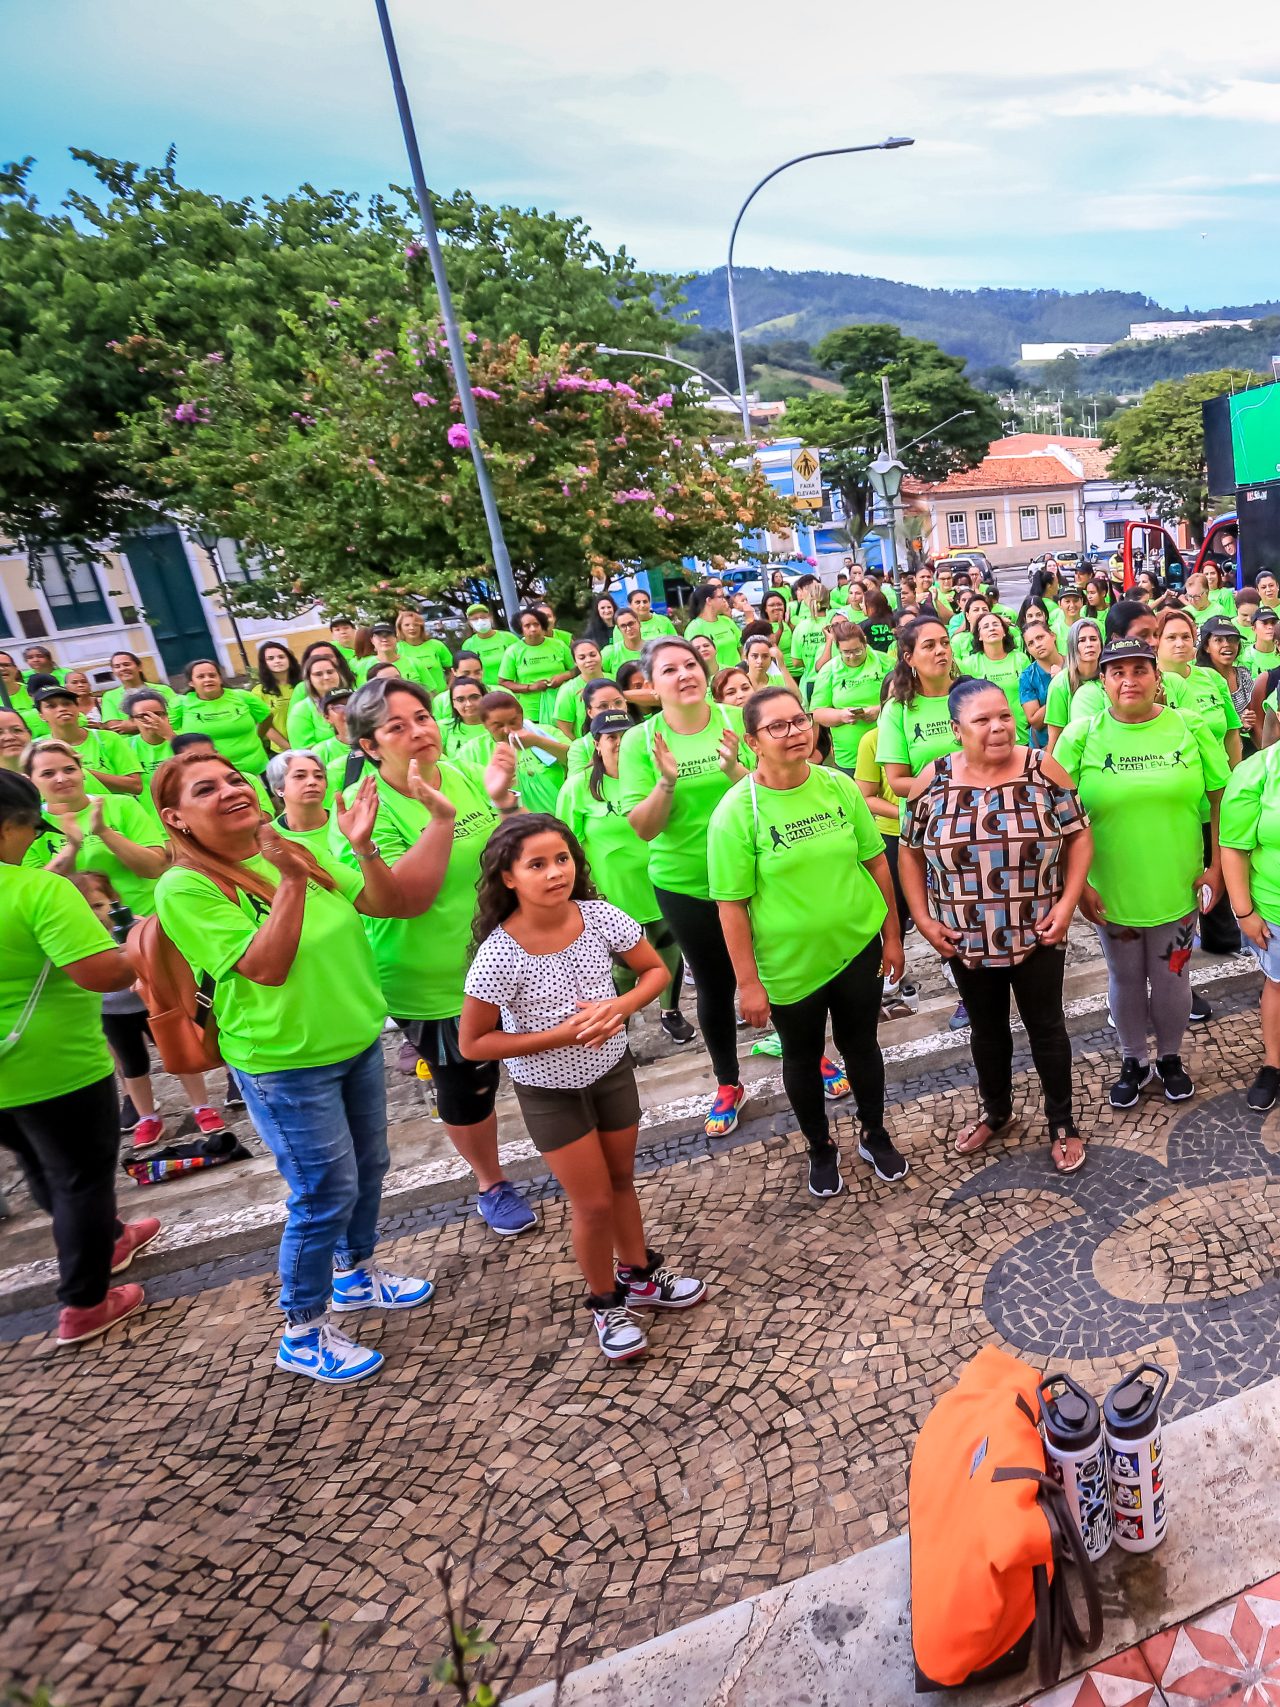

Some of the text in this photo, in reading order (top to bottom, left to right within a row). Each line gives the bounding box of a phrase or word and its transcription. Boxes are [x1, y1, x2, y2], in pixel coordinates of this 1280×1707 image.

[467, 815, 492, 832] LEVE
[784, 811, 832, 831] PARNAÍBA
[786, 825, 814, 842] MAIS
[813, 819, 838, 833] LEVE
